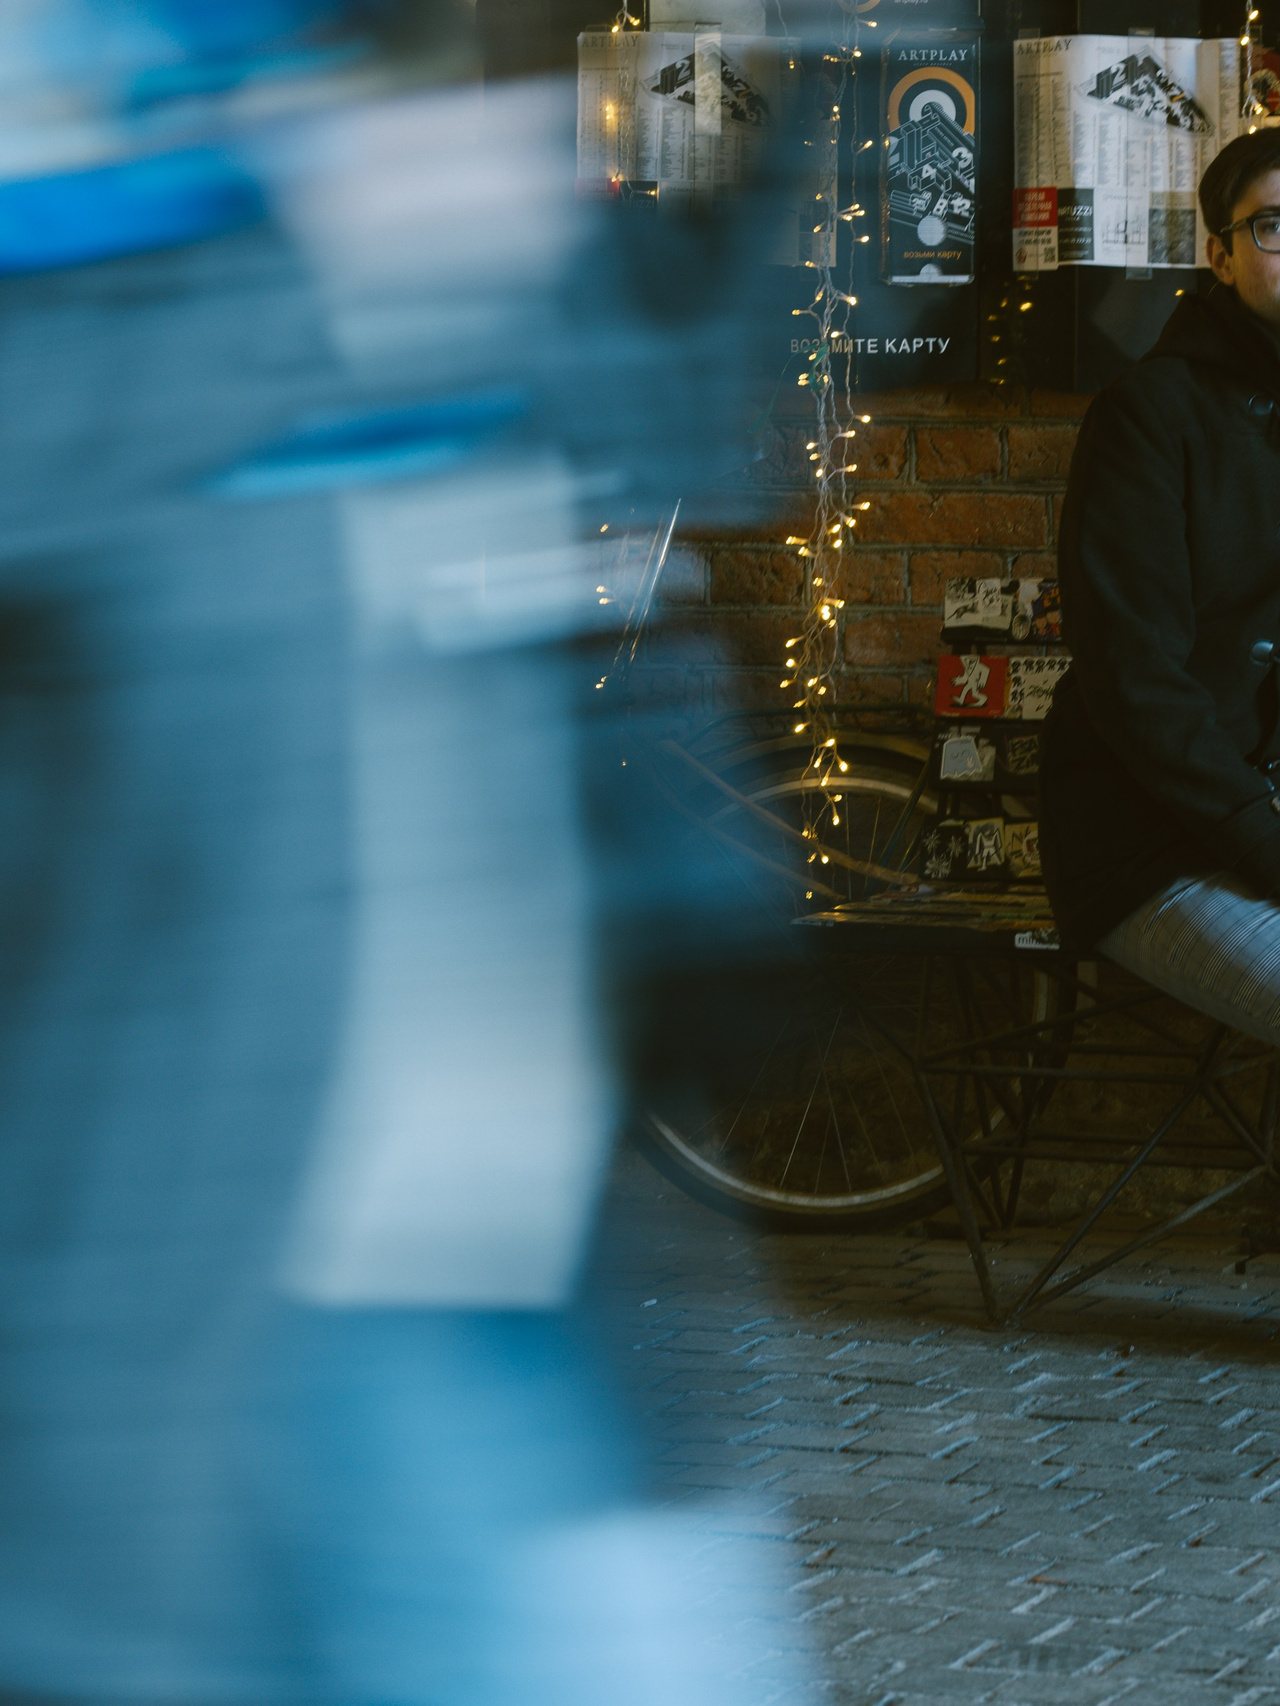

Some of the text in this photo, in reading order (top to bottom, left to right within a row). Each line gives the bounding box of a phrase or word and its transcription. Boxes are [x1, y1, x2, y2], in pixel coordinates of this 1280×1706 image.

[581, 35, 639, 48] ARTPLAY
[1016, 38, 1072, 55] ARTPLAY
[897, 49, 968, 61] ARTPLAY
[904, 250, 962, 260] возьми карту
[790, 337, 951, 355] ВОЗМИТЕ КАРТУ
